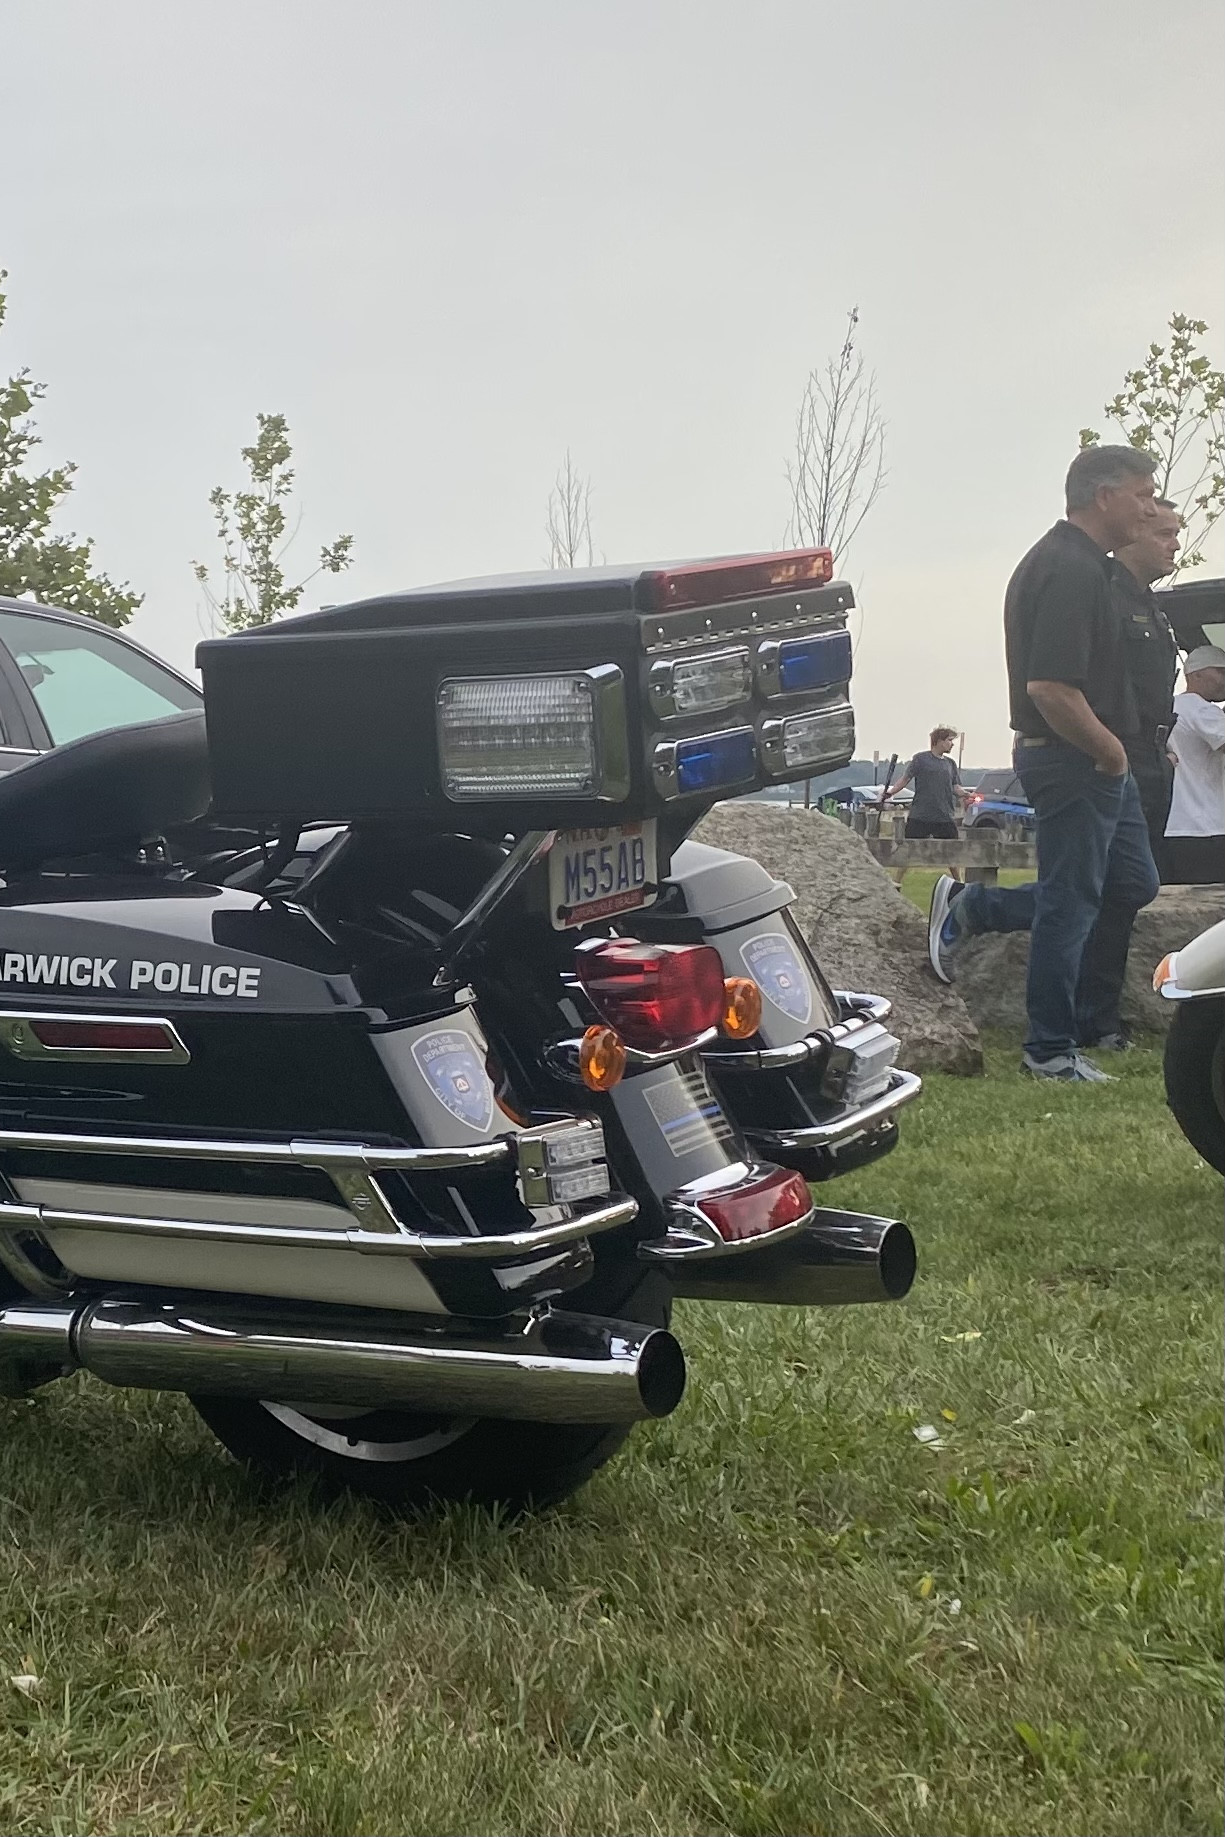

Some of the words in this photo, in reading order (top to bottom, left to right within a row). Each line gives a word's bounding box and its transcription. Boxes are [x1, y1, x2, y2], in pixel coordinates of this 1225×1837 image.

[565, 837, 645, 904] M55AB
[129, 959, 262, 998] POLICE
[422, 1043, 466, 1063] DEPARTMENT
[426, 1035, 454, 1049] POLICE
[435, 1088, 454, 1107] CITY
[454, 1107, 467, 1118] OF
